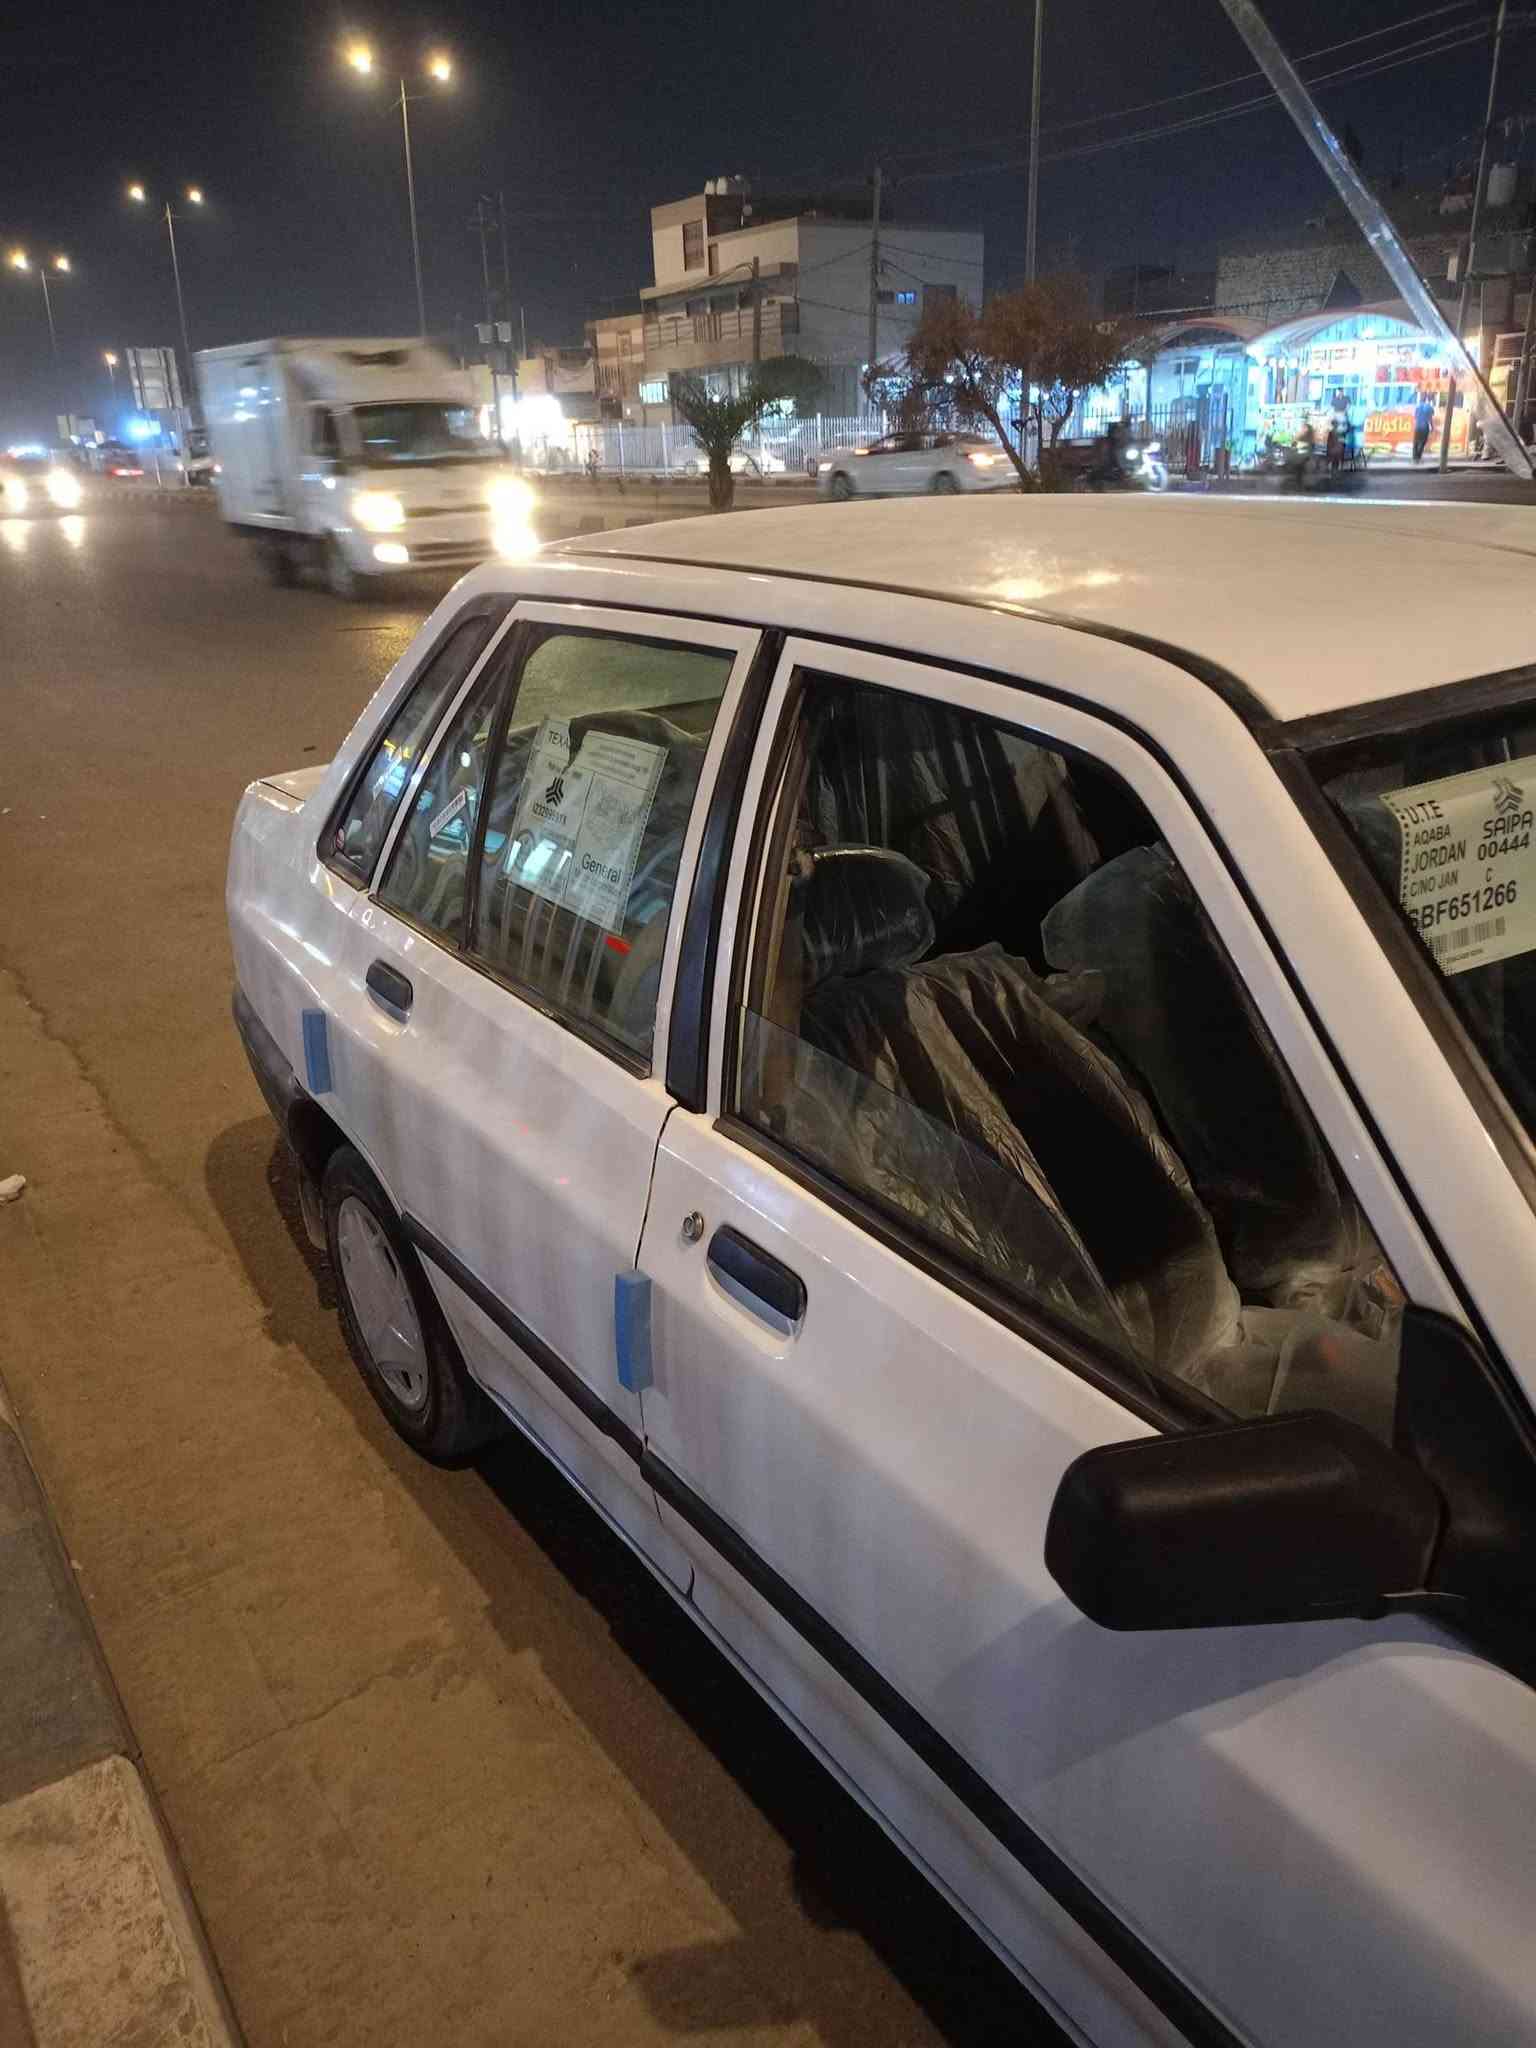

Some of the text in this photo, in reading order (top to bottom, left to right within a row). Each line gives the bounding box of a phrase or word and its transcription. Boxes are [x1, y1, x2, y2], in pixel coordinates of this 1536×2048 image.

[1414, 824, 1450, 845] AQABA
[1483, 811, 1533, 839] SAIPA
[1411, 839, 1466, 873] JORDAN
[1478, 832, 1530, 860] 00444
[582, 852, 622, 883] General
[1438, 869, 1458, 889] JAN
